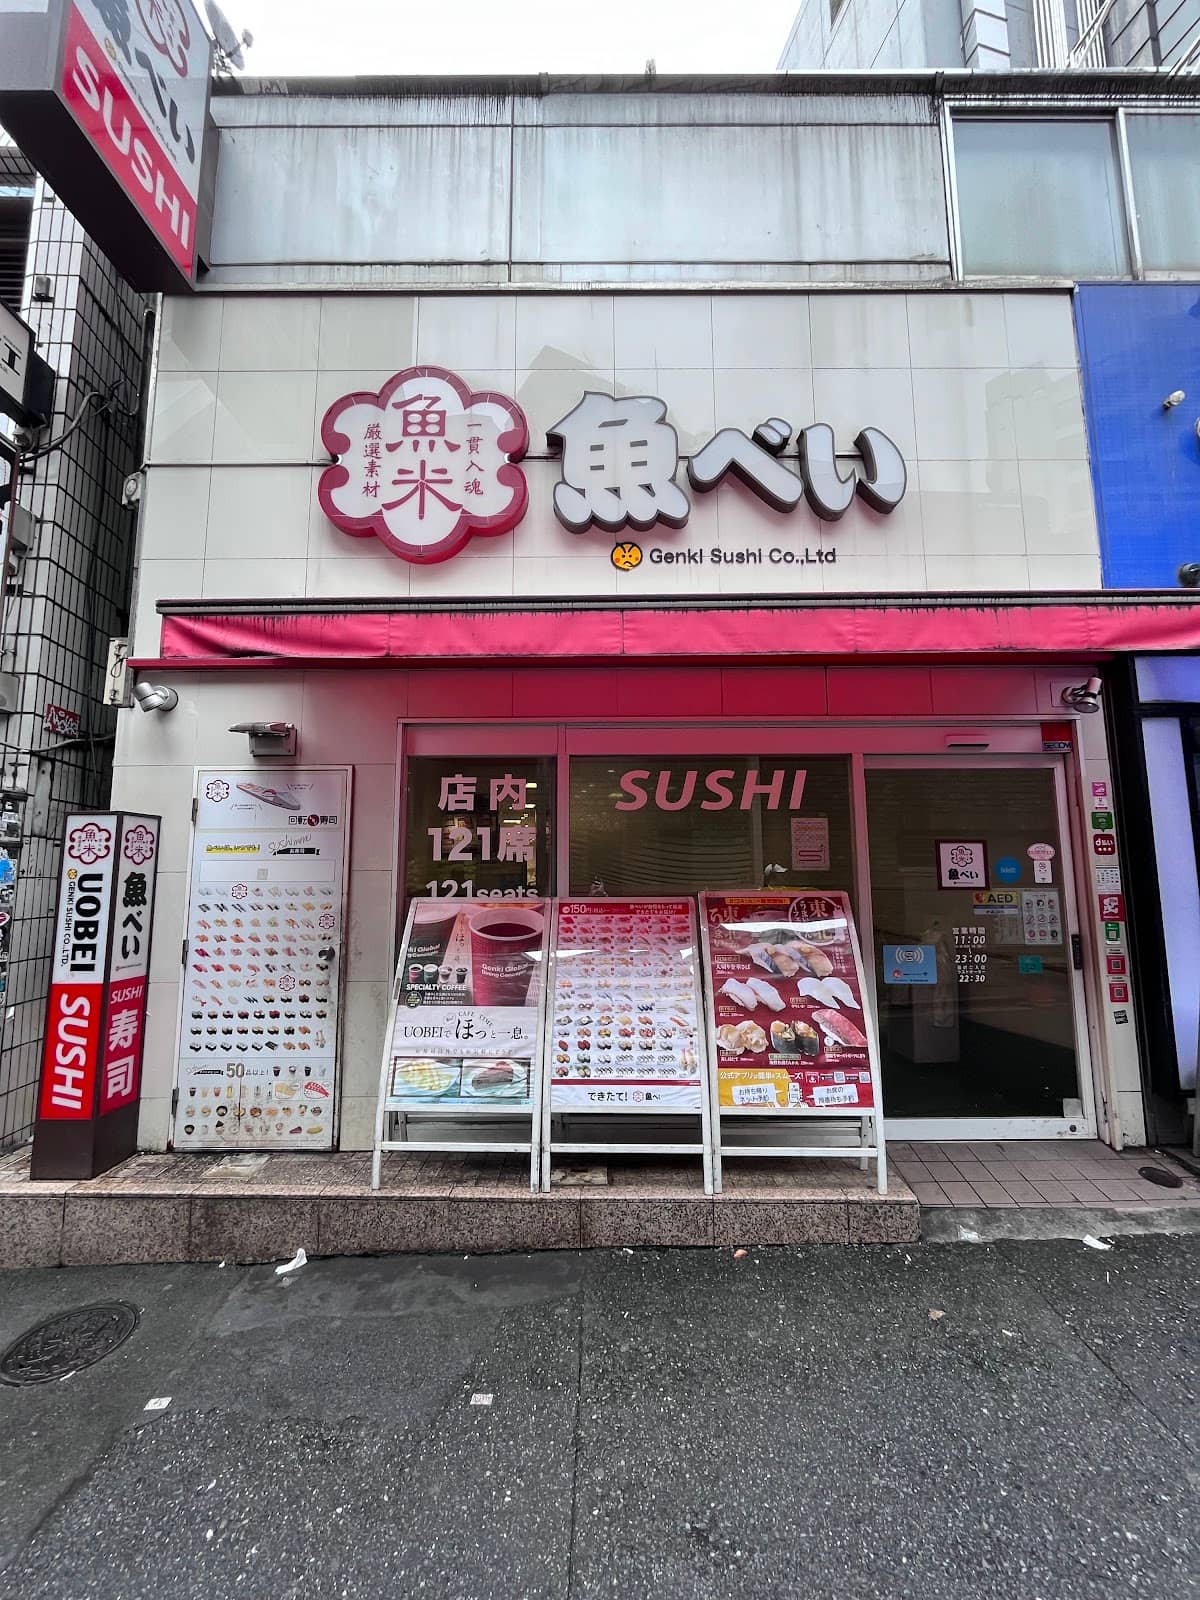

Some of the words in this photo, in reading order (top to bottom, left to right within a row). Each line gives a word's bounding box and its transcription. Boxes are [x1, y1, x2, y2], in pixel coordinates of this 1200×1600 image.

[71, 46, 190, 250] SUSHI
[361, 422, 383, 498] 厳選素材
[463, 422, 485, 496] 一貫入魂
[545, 390, 908, 534] 魚べい
[649, 547, 704, 564] Genki
[710, 547, 763, 564] Sushi
[768, 547, 837, 566] Co.,Ltd
[437, 773, 527, 812] 店内
[614, 769, 808, 811] SUSHI
[427, 826, 537, 863] 121席
[948, 868, 979, 881] 魚べい
[121, 871, 147, 960] 魚べい
[987, 893, 1014, 903] AED
[64, 907, 75, 932] SUSHI
[70, 872, 104, 972] UOBEI
[954, 935, 986, 945] 11:00
[954, 954, 988, 963] 23:00
[110, 985, 143, 1005] SUSHI
[405, 983, 441, 991] SPECIALTY
[441, 983, 468, 991] COFFEE
[958, 974, 987, 983] 22:30
[51, 993, 91, 1110] SUSHI
[106, 1008, 139, 1100] 寿司
